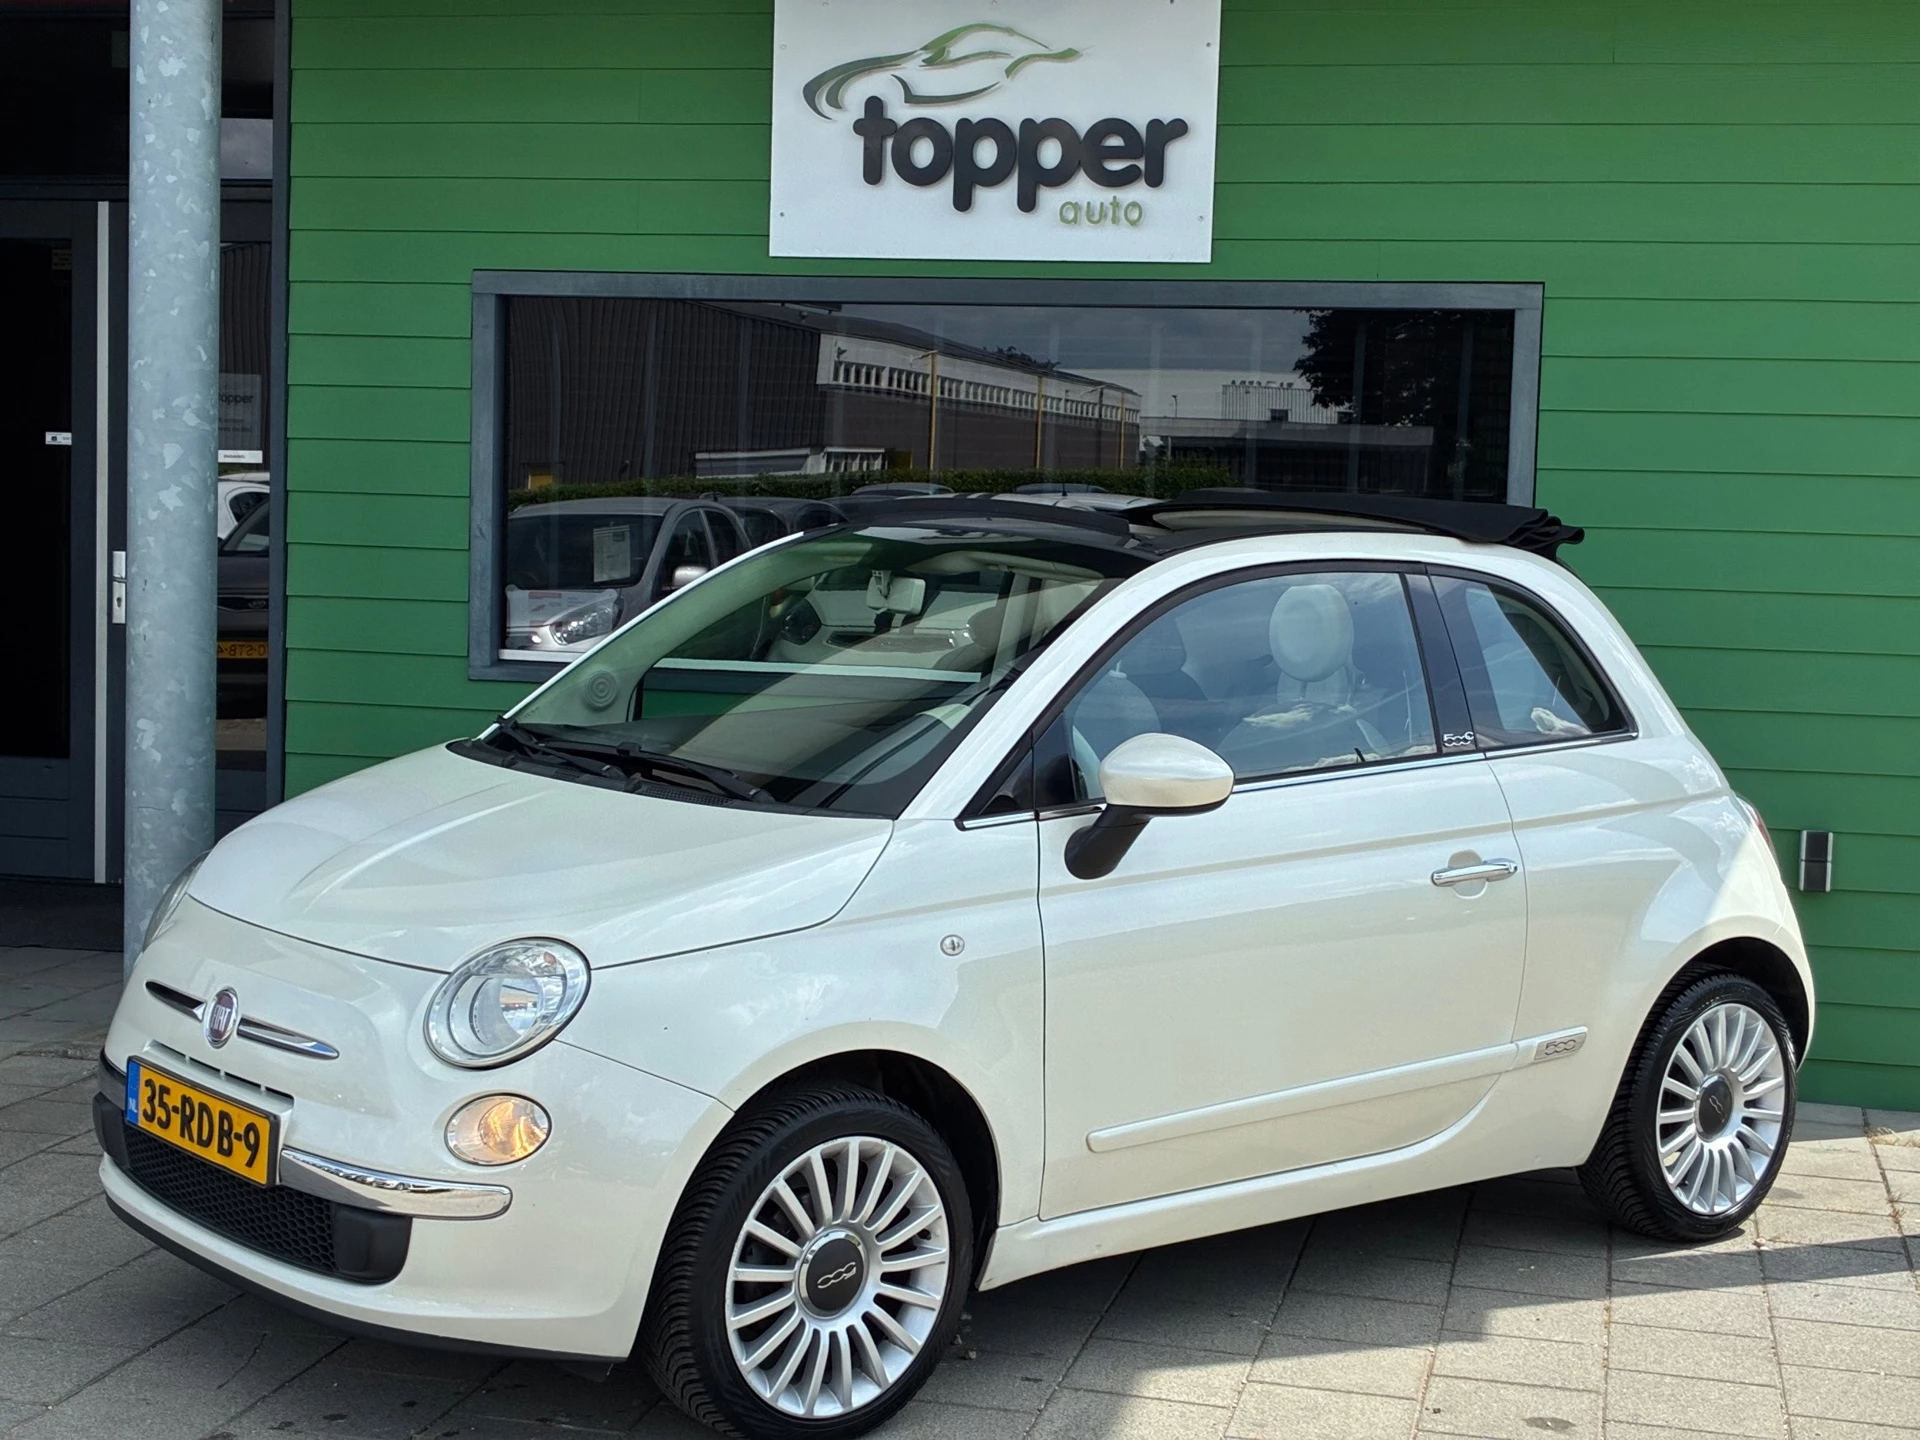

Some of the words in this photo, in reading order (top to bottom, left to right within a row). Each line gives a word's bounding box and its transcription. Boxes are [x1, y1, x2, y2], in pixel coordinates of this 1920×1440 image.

[853, 95, 1188, 213] topper
[1058, 195, 1143, 227] auto
[219, 394, 253, 406] opper
[211, 1004, 231, 1032] FIAT
[1544, 1039, 1576, 1056] 500
[128, 1096, 138, 1113] NL
[142, 1078, 260, 1168] 35-RDB-9
